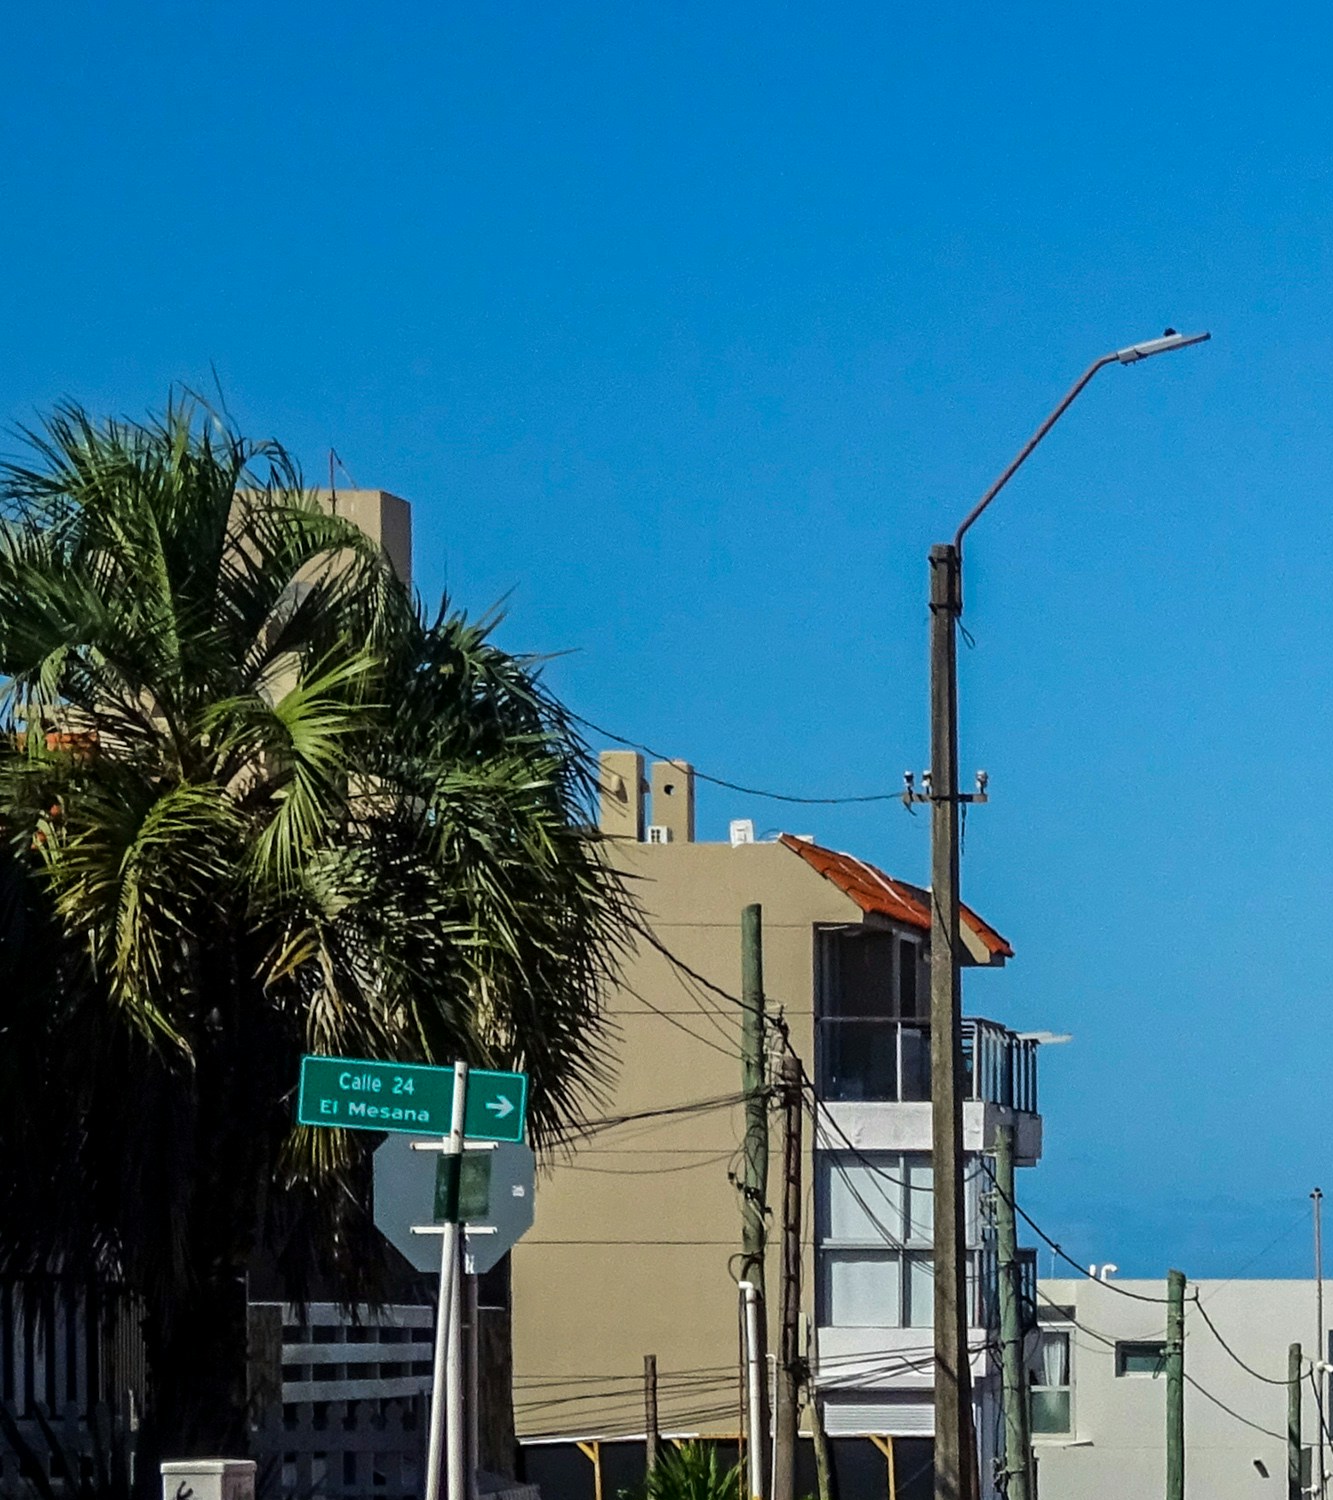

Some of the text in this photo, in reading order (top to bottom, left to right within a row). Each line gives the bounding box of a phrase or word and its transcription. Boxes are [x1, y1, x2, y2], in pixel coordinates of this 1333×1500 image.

[339, 1071, 415, 1096] Calle 24
[320, 1099, 430, 1123] El Mesana
